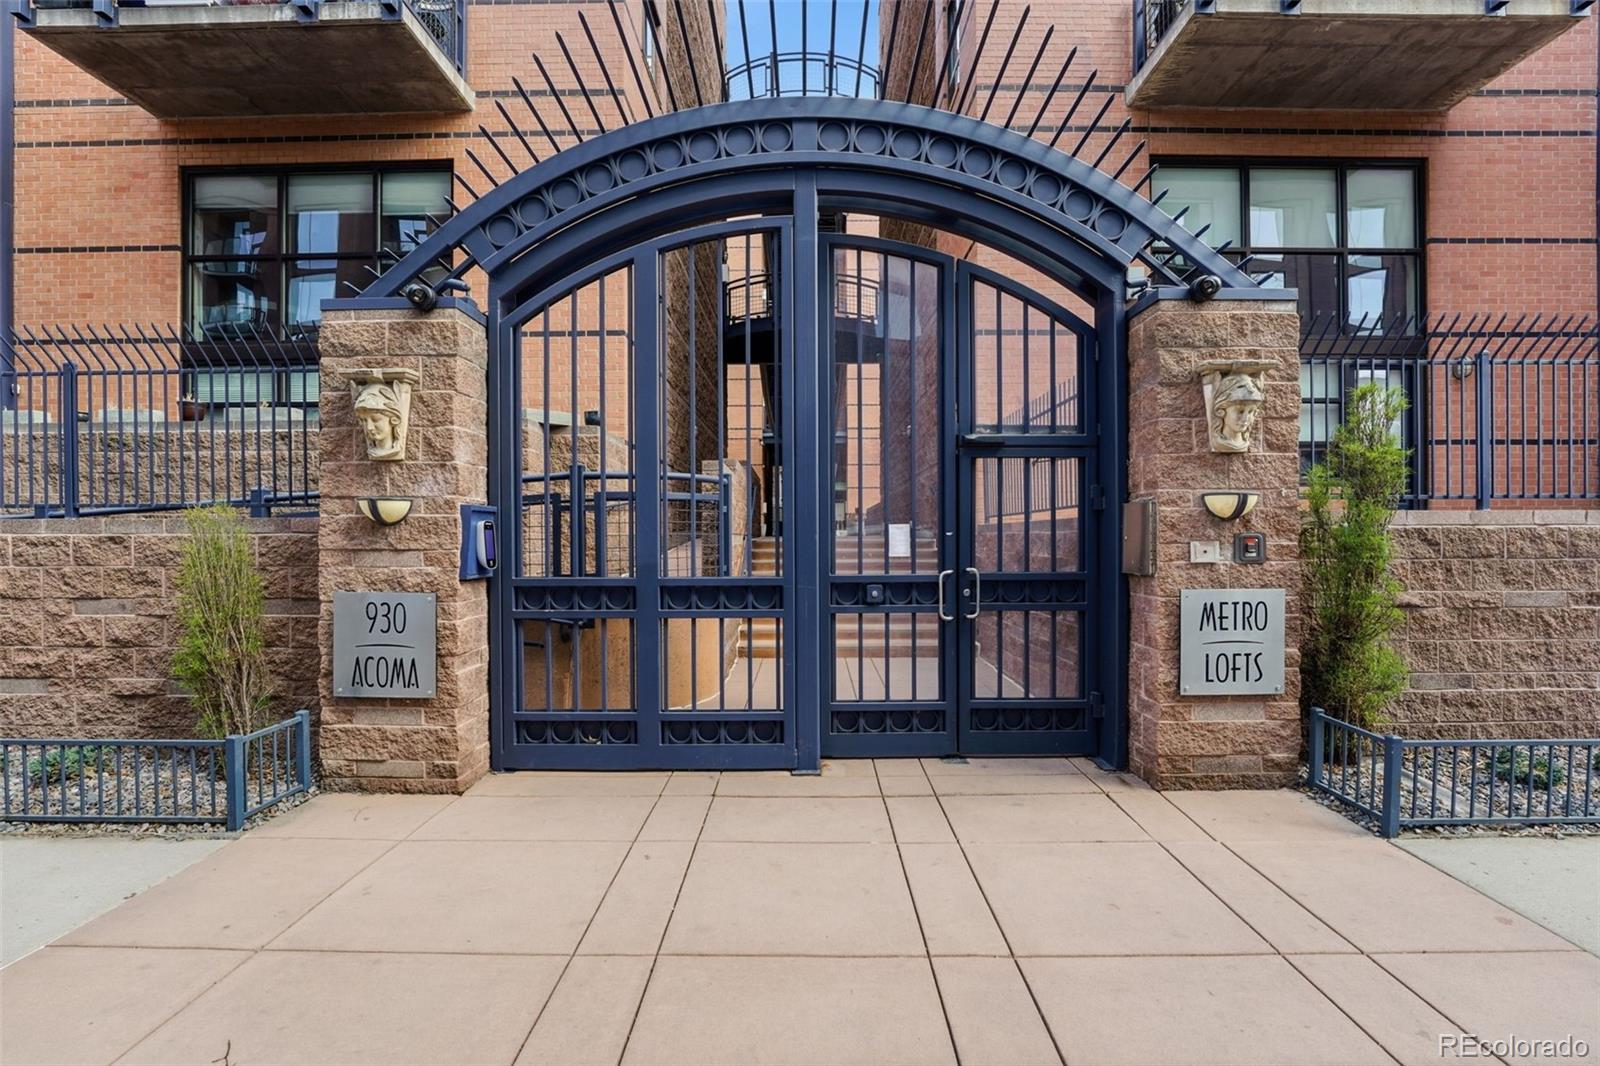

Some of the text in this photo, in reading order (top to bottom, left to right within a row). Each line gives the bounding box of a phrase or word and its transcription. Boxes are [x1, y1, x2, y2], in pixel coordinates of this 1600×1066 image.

[366, 602, 406, 633] 930
[1199, 601, 1268, 631] METRO
[351, 656, 419, 688] ACOMA
[1205, 652, 1263, 683] LOFTS
